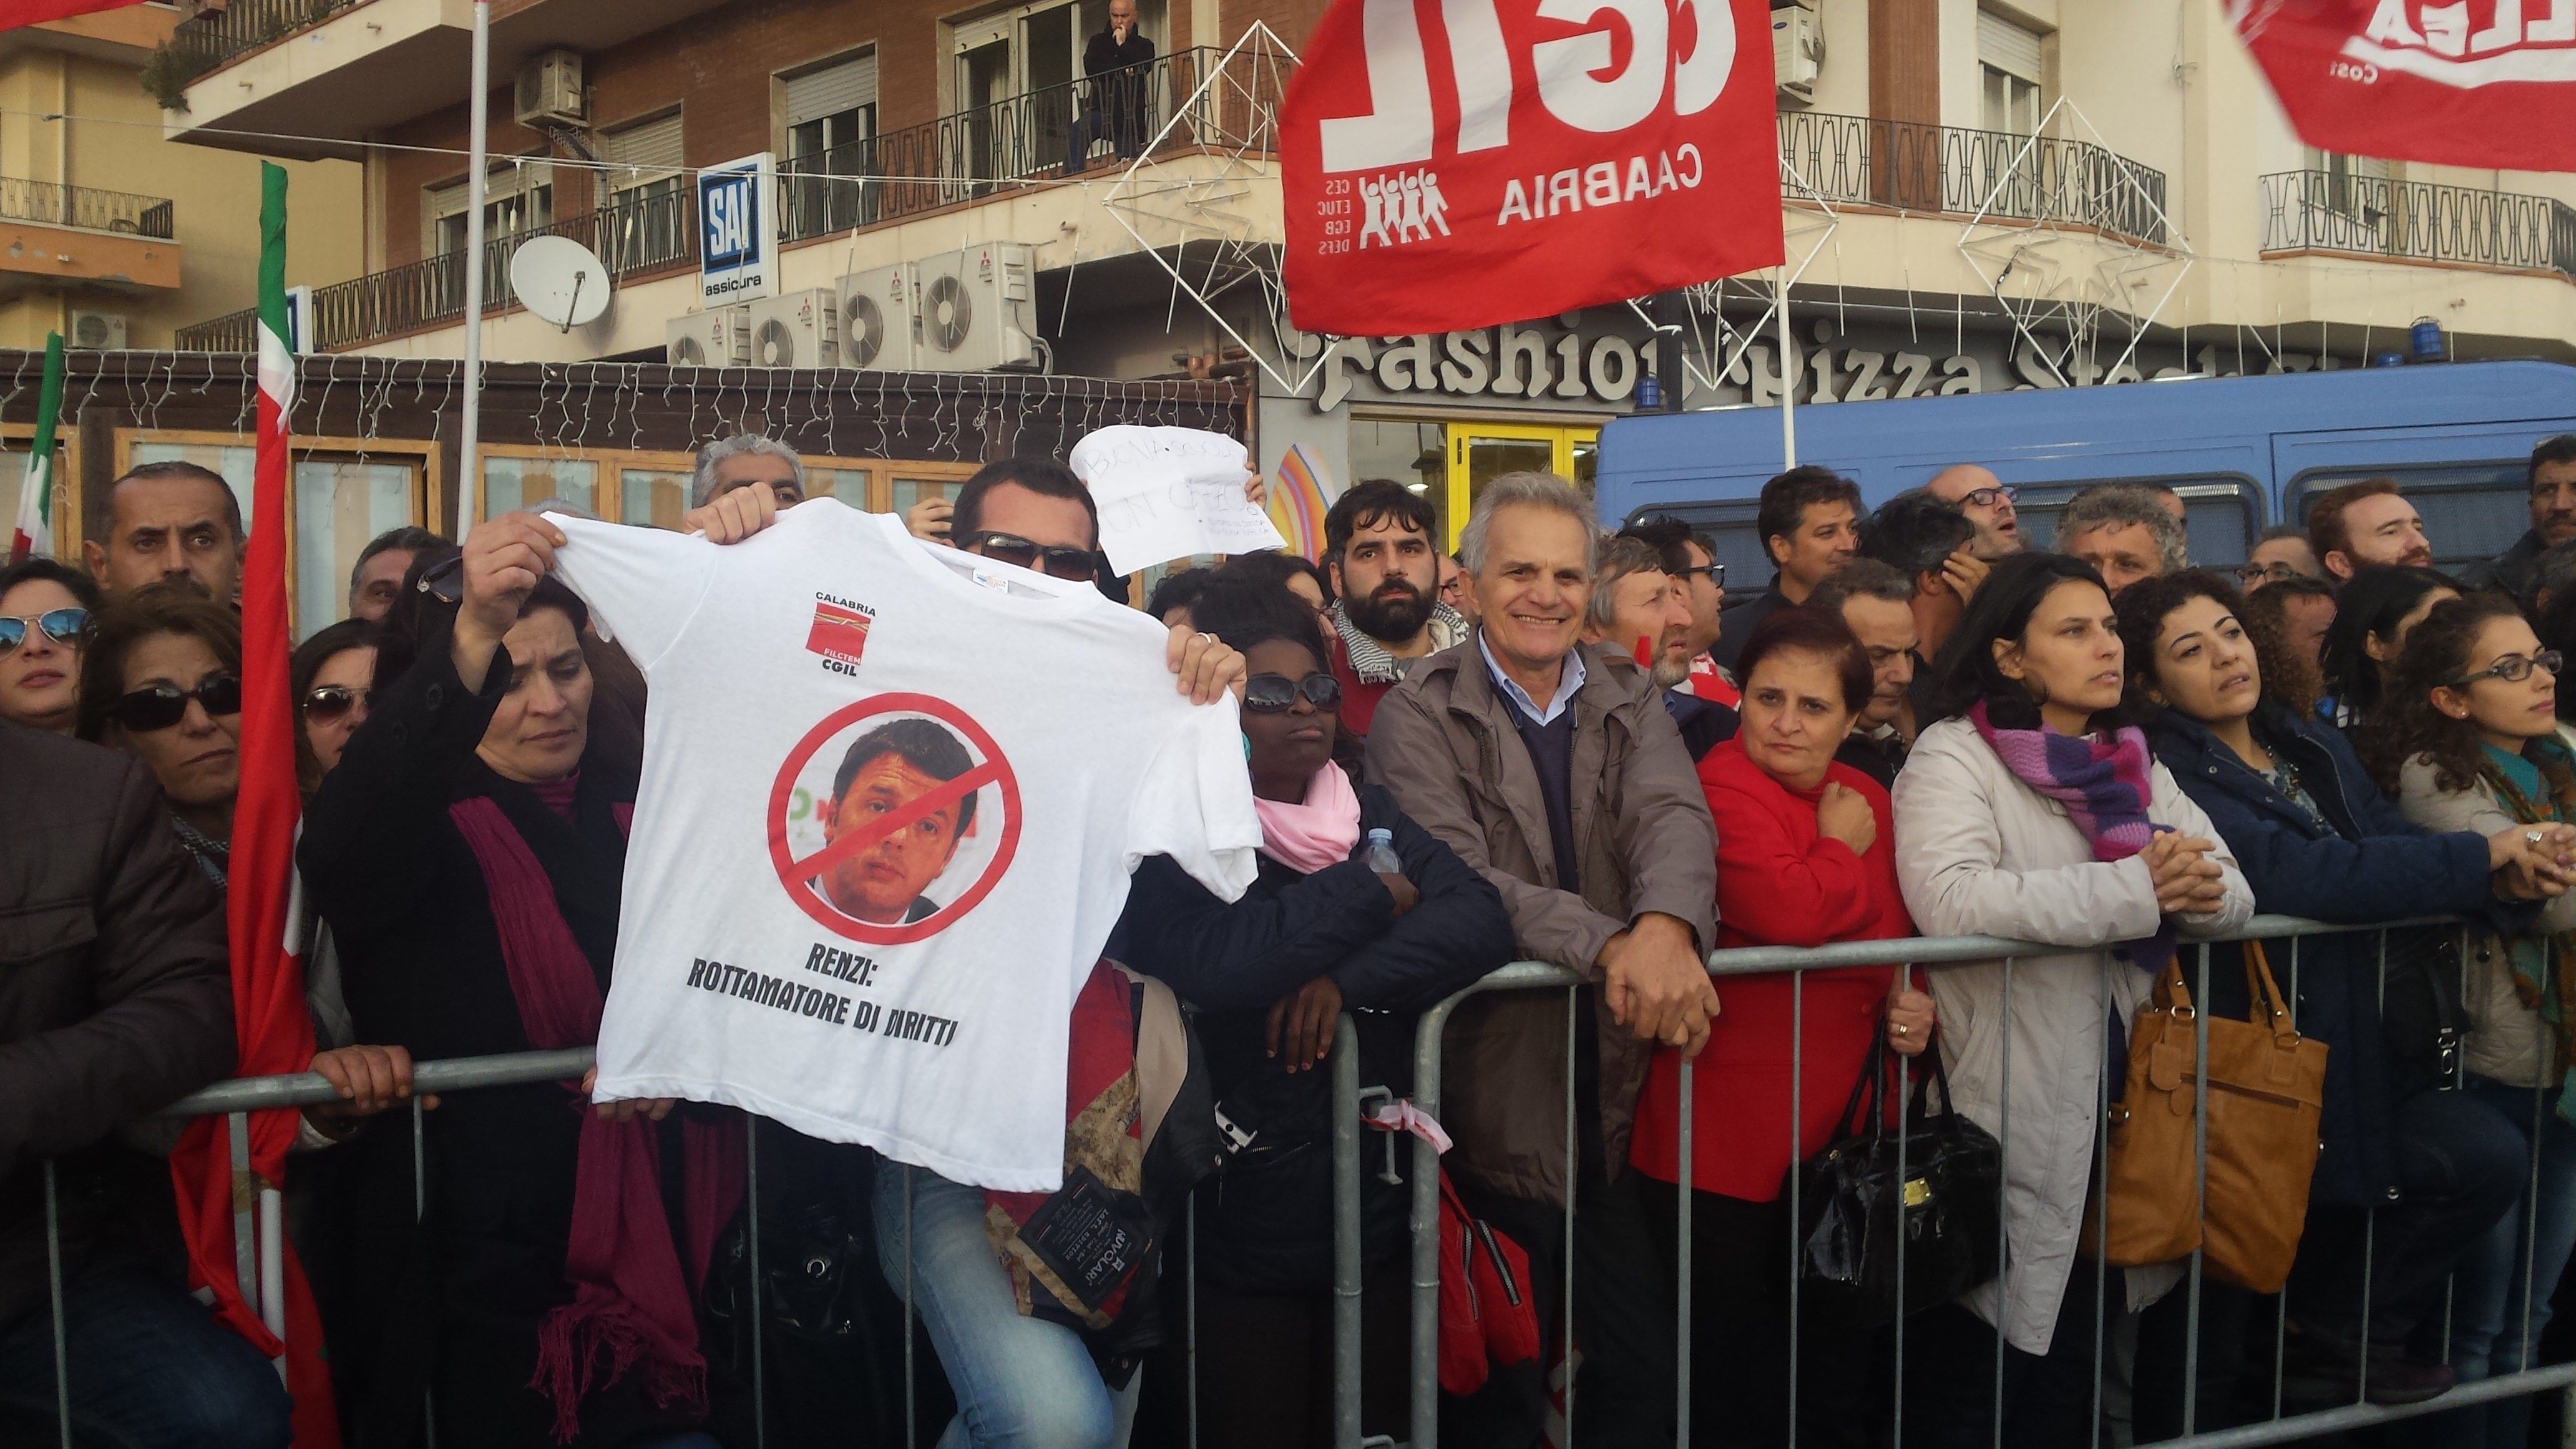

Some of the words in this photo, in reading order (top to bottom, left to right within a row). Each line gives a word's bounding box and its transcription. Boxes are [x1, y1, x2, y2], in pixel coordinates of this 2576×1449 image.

[708, 181, 749, 256] SAI
[705, 275, 762, 296] assicura
[816, 592, 876, 617] CALABRIA
[822, 658, 857, 677] CGIL
[823, 648, 861, 665] FILCTEM
[805, 942, 878, 987] RENZI:
[686, 957, 851, 1025] ROTTAMATORE
[853, 1001, 881, 1032] DI
[884, 1008, 959, 1046] DIRITTI
